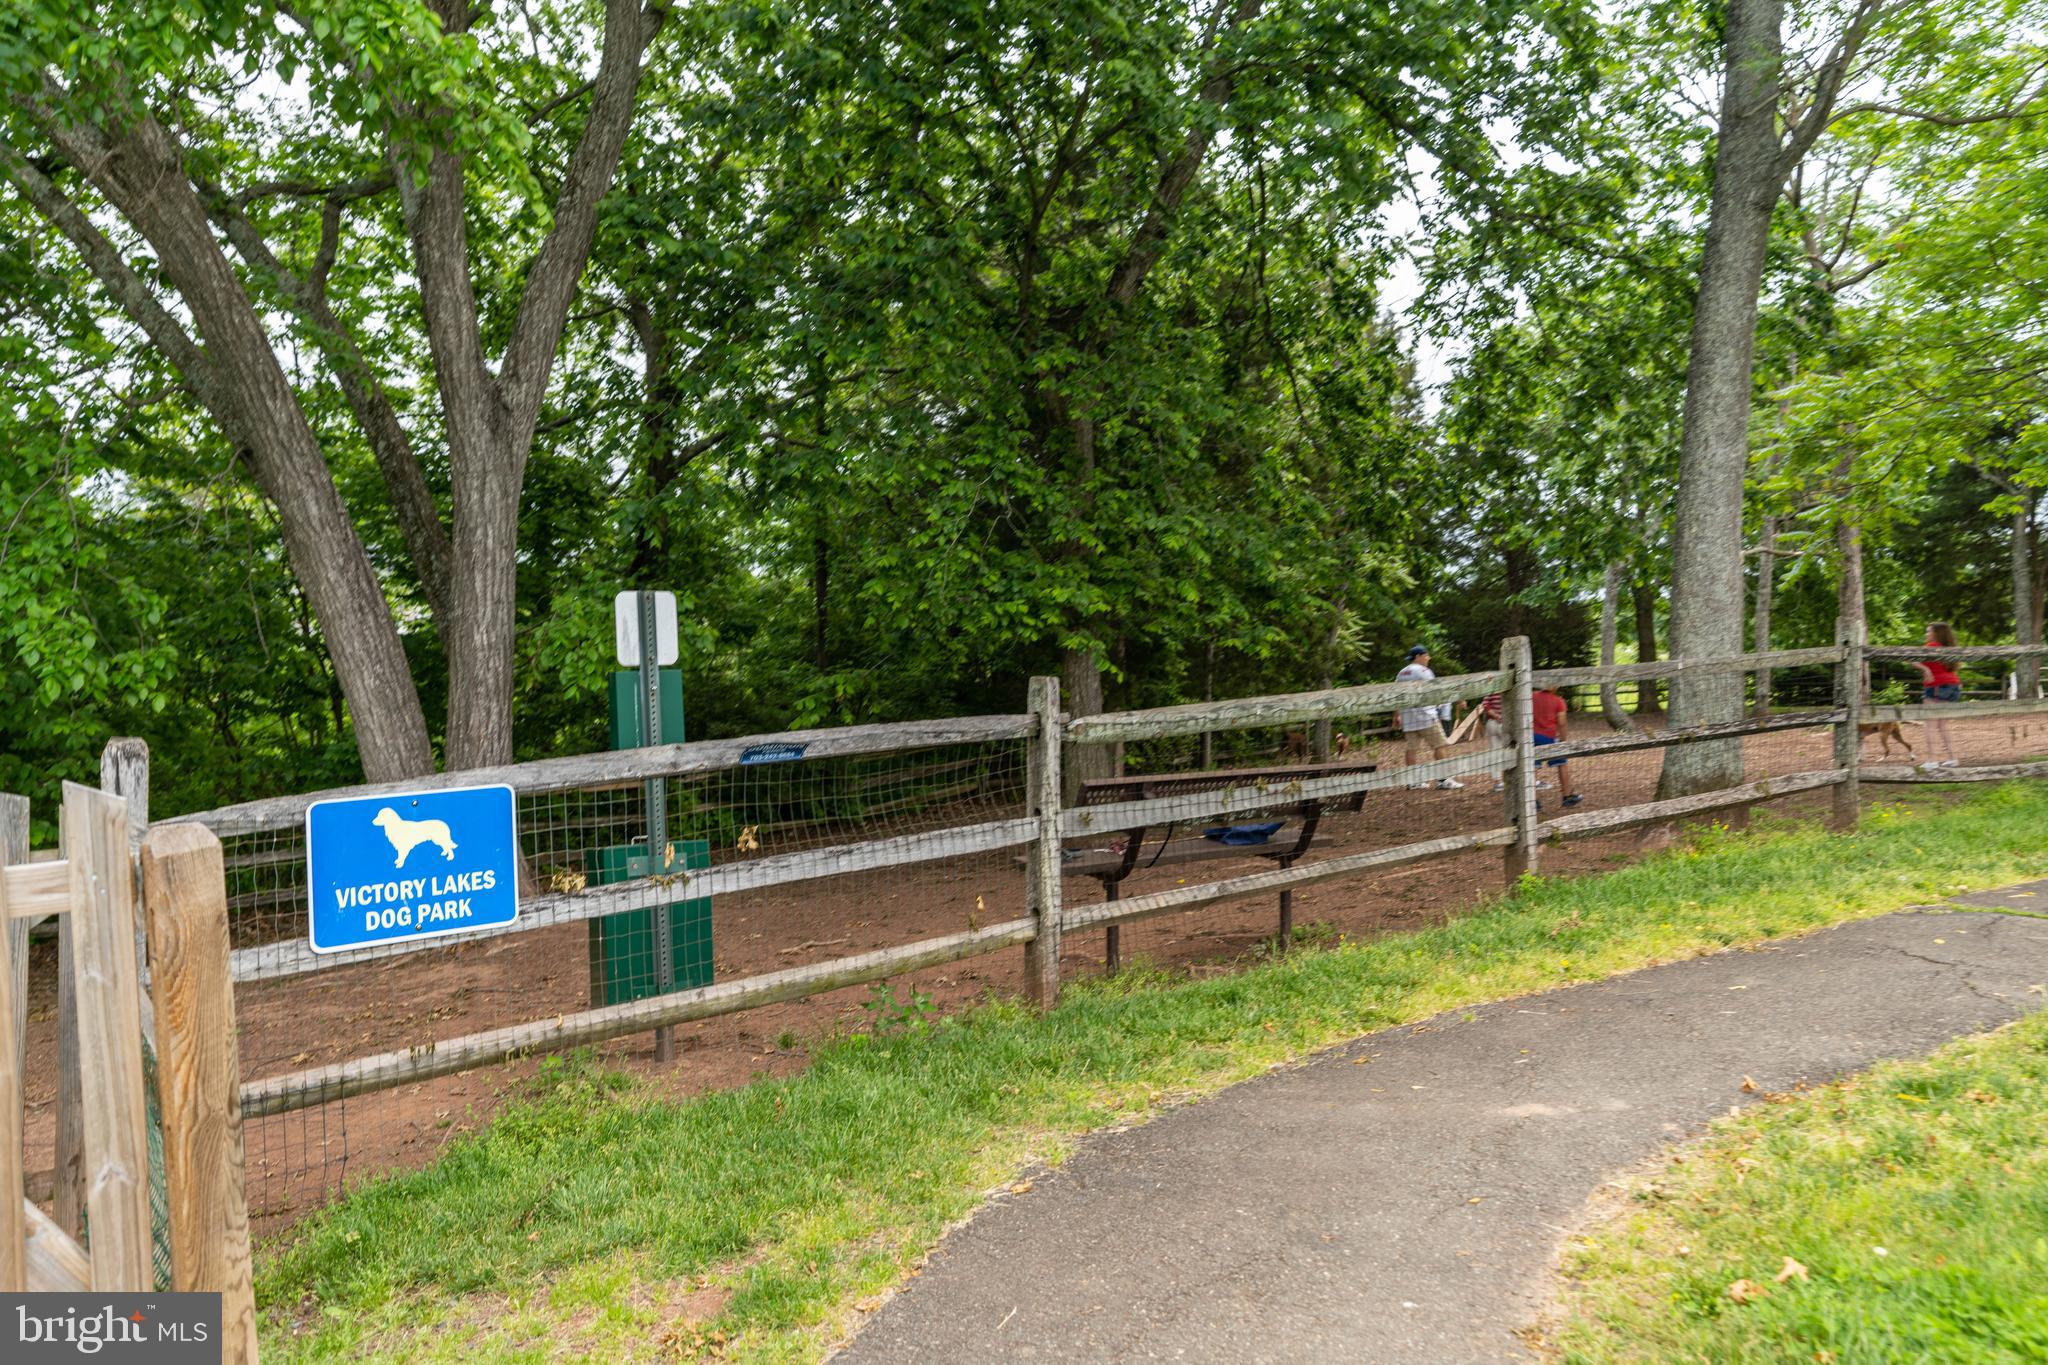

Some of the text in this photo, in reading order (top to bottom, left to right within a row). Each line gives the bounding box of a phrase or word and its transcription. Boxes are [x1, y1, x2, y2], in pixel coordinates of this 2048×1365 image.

[335, 870, 496, 909] VICTORY LAKES
[365, 898, 473, 931] DOG PARK
